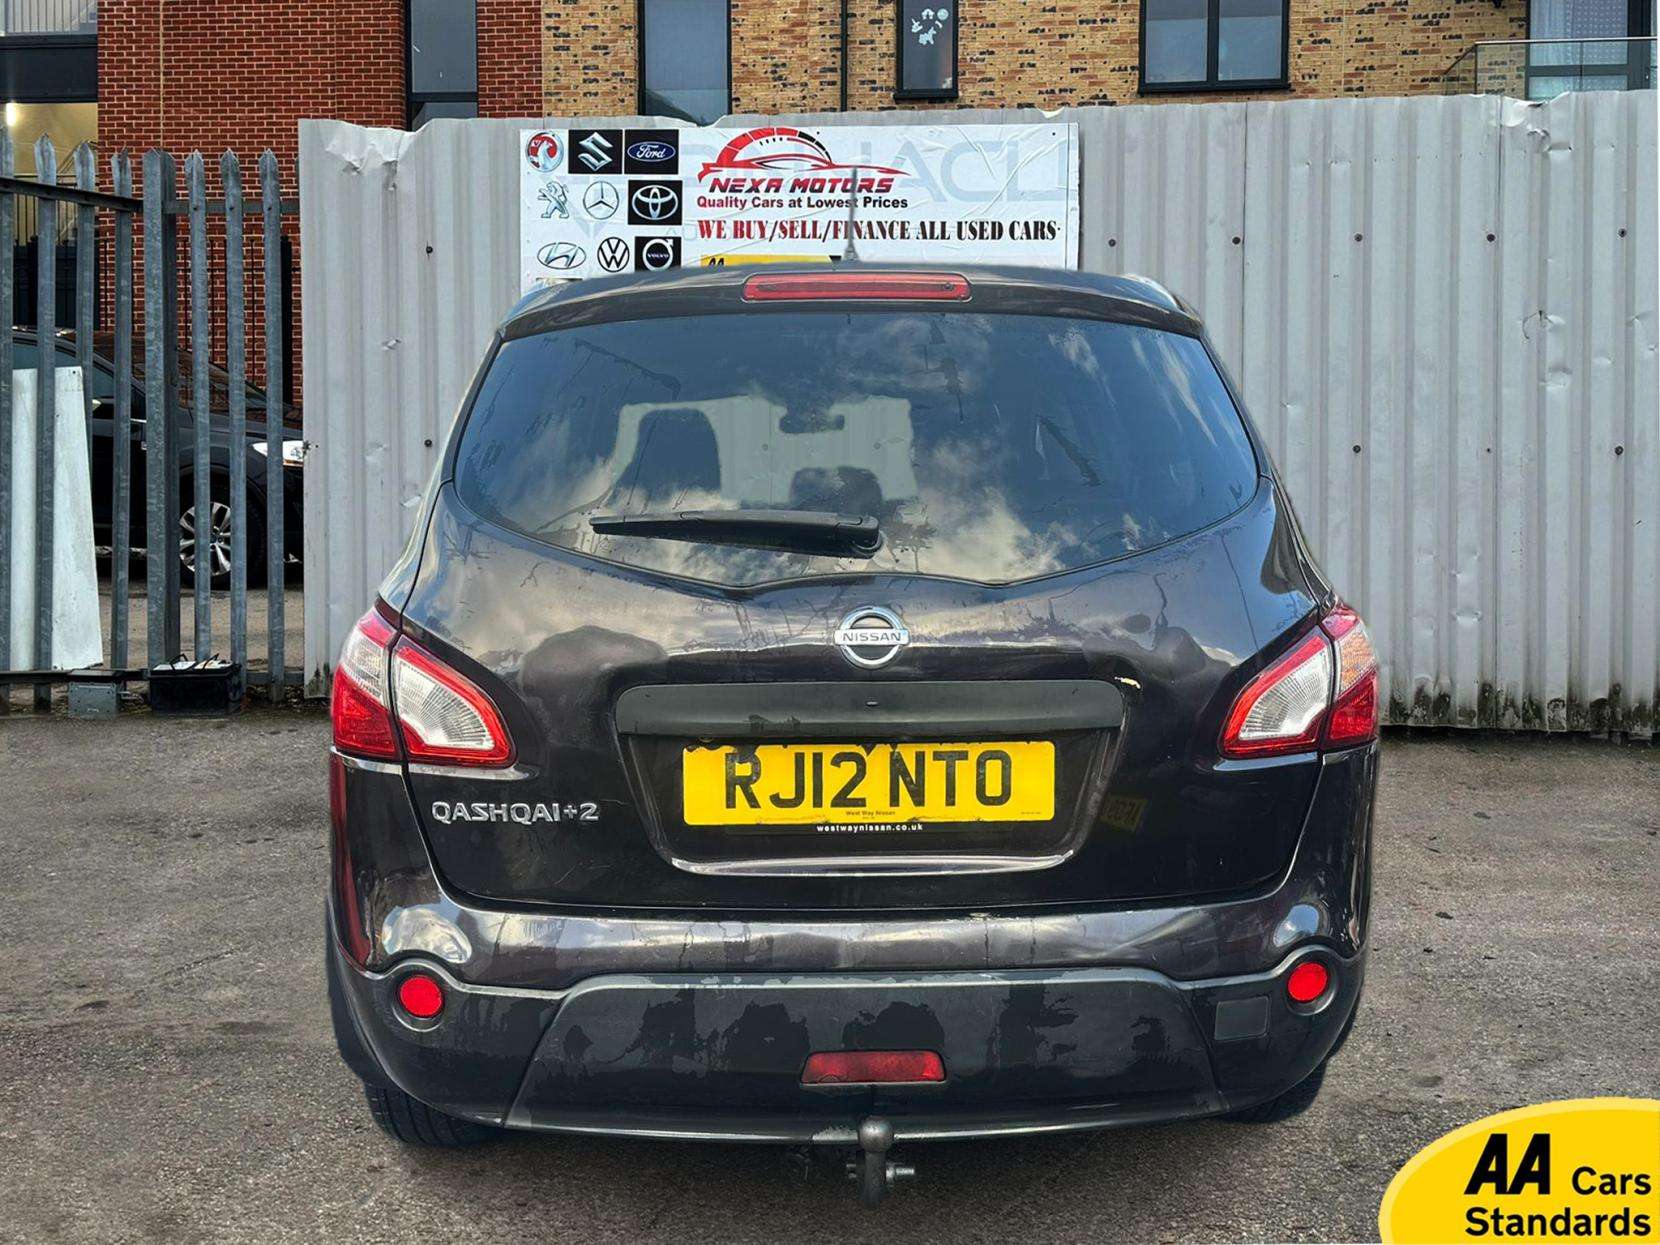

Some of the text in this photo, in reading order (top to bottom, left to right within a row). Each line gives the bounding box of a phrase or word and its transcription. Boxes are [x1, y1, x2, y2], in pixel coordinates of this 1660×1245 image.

[636, 144, 666, 158] Ford
[709, 178, 895, 194] NEXA MOTORS
[697, 196, 909, 211] Quality Cars at Lowest Prices
[697, 220, 727, 240] WE
[916, 220, 952, 240] ALL
[957, 220, 1004, 240] USED
[842, 632, 901, 642] NISSAN
[725, 749, 1013, 809] RJ12 NTO
[431, 801, 600, 825] QASHQAI+2
[816, 823, 923, 833] westwaynissan.co.uk
